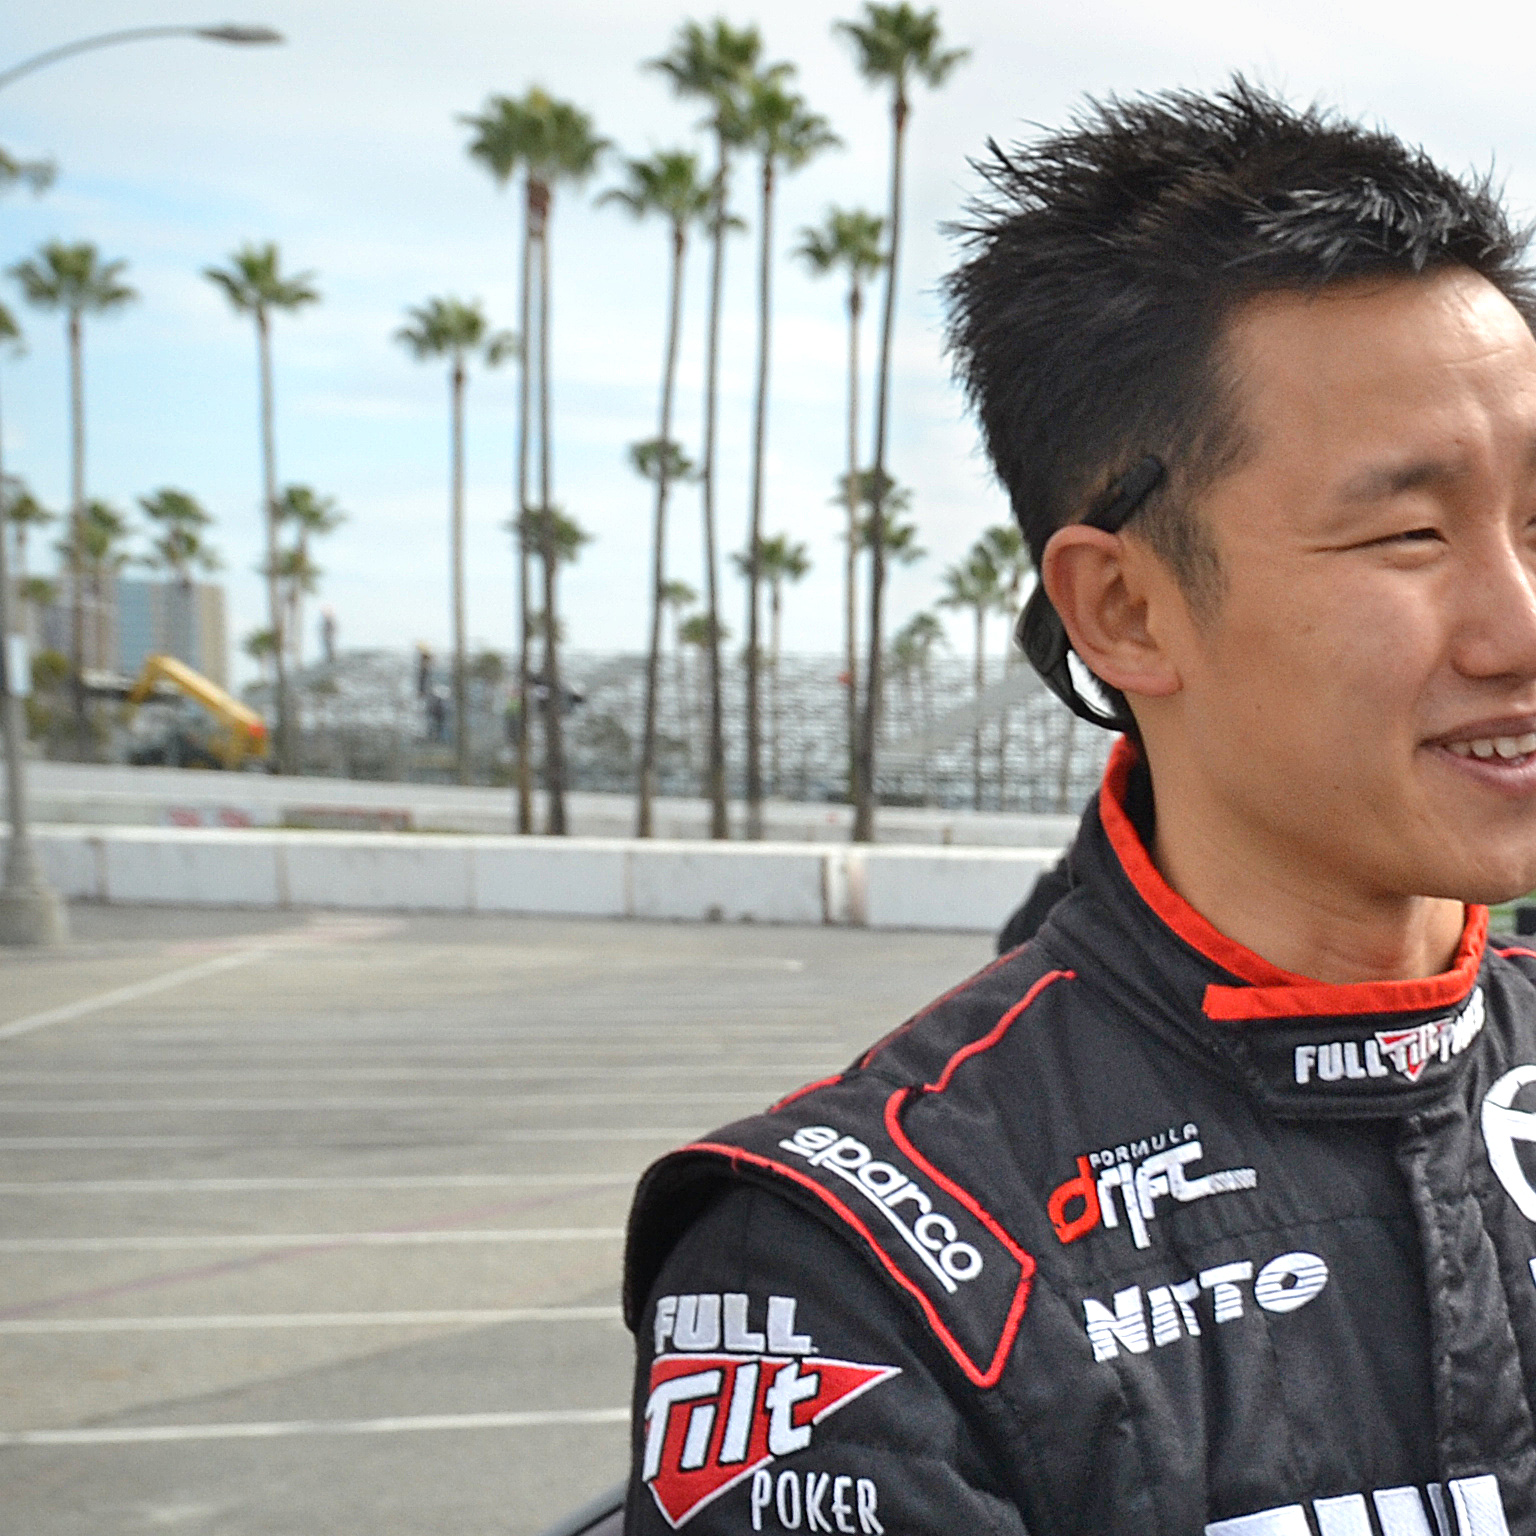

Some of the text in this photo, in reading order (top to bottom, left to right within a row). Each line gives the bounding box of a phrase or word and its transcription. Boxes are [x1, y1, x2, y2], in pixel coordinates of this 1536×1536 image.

[1295, 1038, 1389, 1084] FULL
[1089, 1122, 1199, 1168] FORMULA
[783, 1126, 984, 1288] sparco
[654, 1294, 814, 1355] FULL
